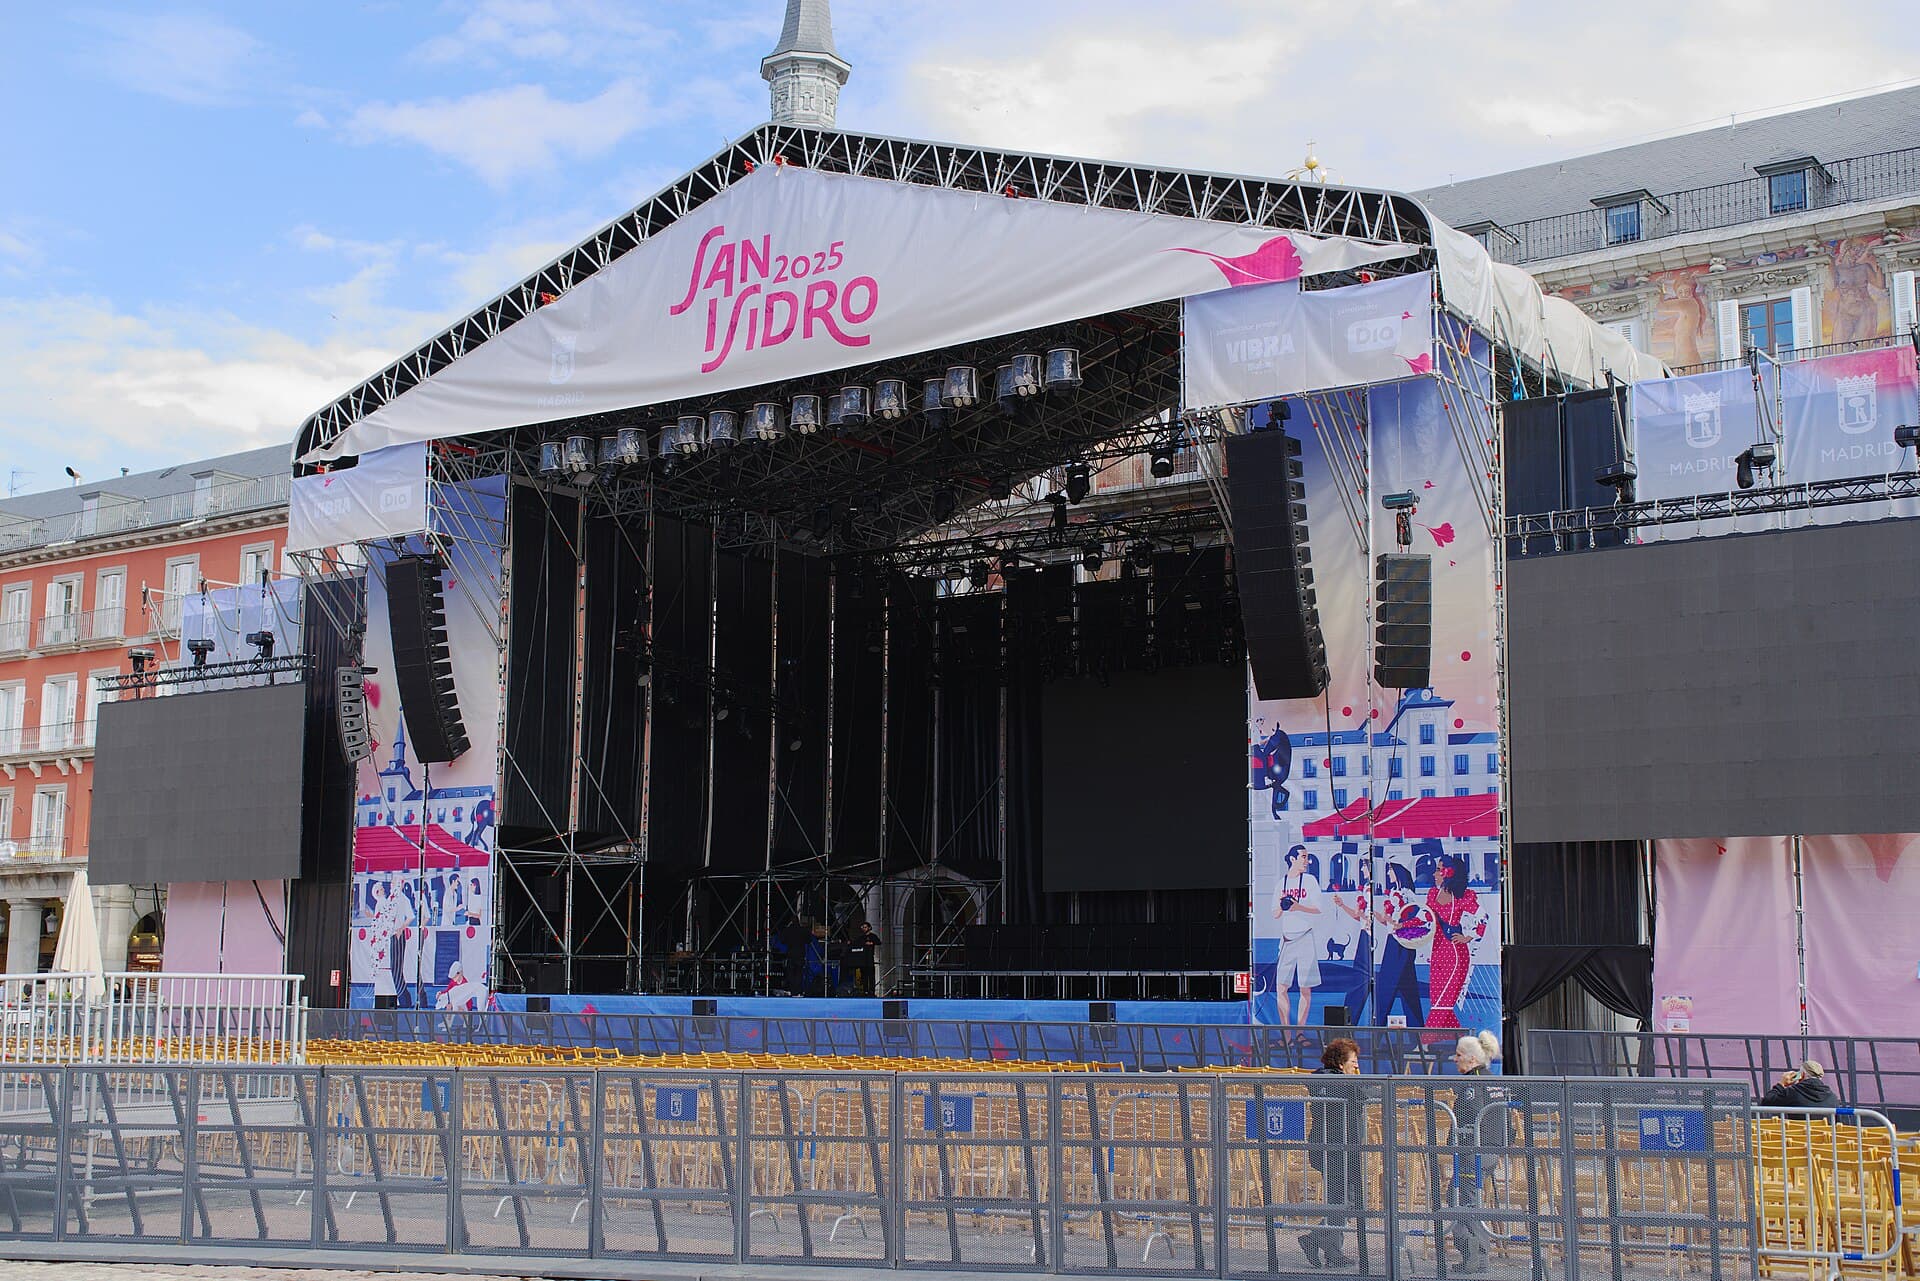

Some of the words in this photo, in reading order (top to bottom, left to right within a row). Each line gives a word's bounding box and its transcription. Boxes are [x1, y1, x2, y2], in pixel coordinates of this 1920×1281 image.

[670, 225, 770, 316] SAN
[773, 241, 844, 284] 2025
[701, 275, 879, 374] ISIDRO
[1225, 333, 1296, 364] VIBRA
[1821, 441, 1897, 463] MADRID
